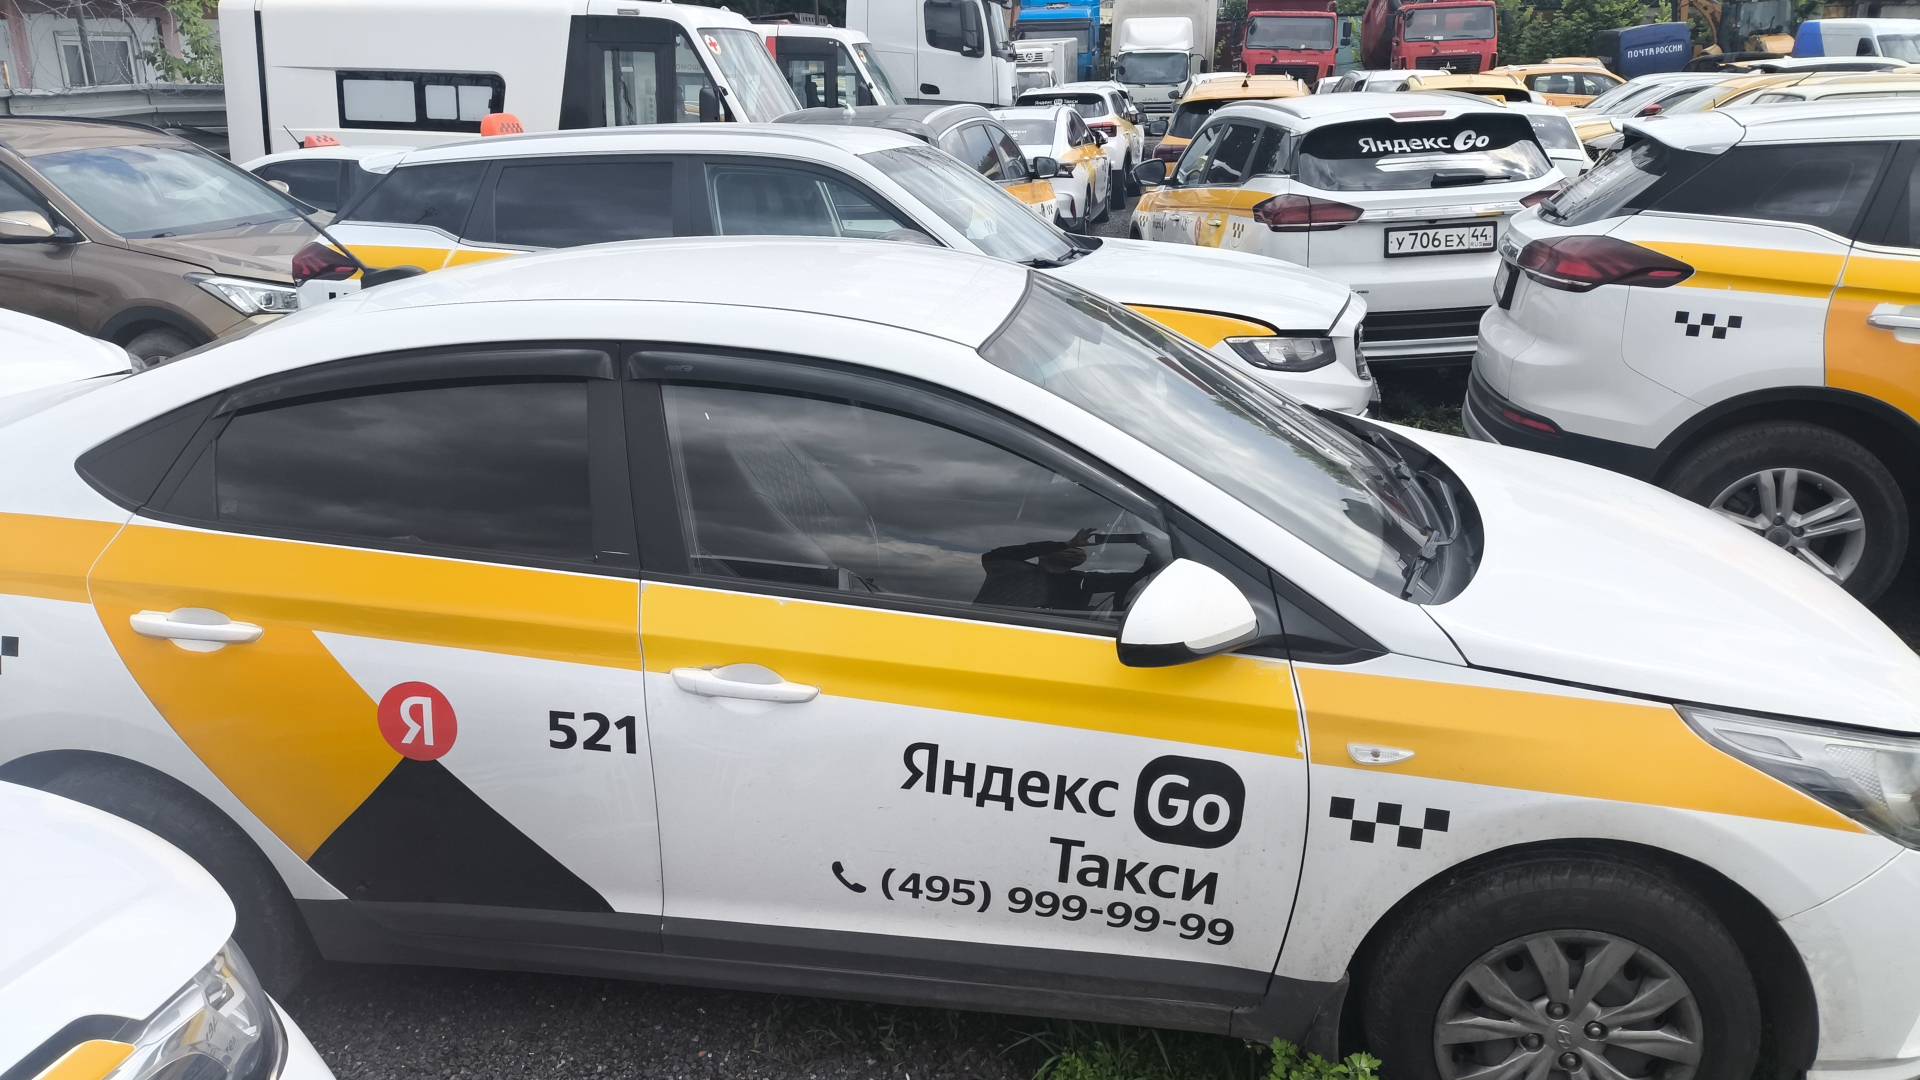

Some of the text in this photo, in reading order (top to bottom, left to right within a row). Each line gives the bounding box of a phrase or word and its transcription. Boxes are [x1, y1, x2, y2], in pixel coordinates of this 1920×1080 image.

[1627, 44, 1683, 59] ПОЧТА РОССИИ
[1358, 129, 1490, 153] Яндекс Go
[1471, 227, 1488, 242] 44
[400, 695, 434, 746] Я
[549, 710, 638, 755] 521
[900, 741, 1232, 833] Яндекс Go
[1049, 836, 1220, 906] Такси
[881, 867, 1235, 946] (495) 999-99-99
